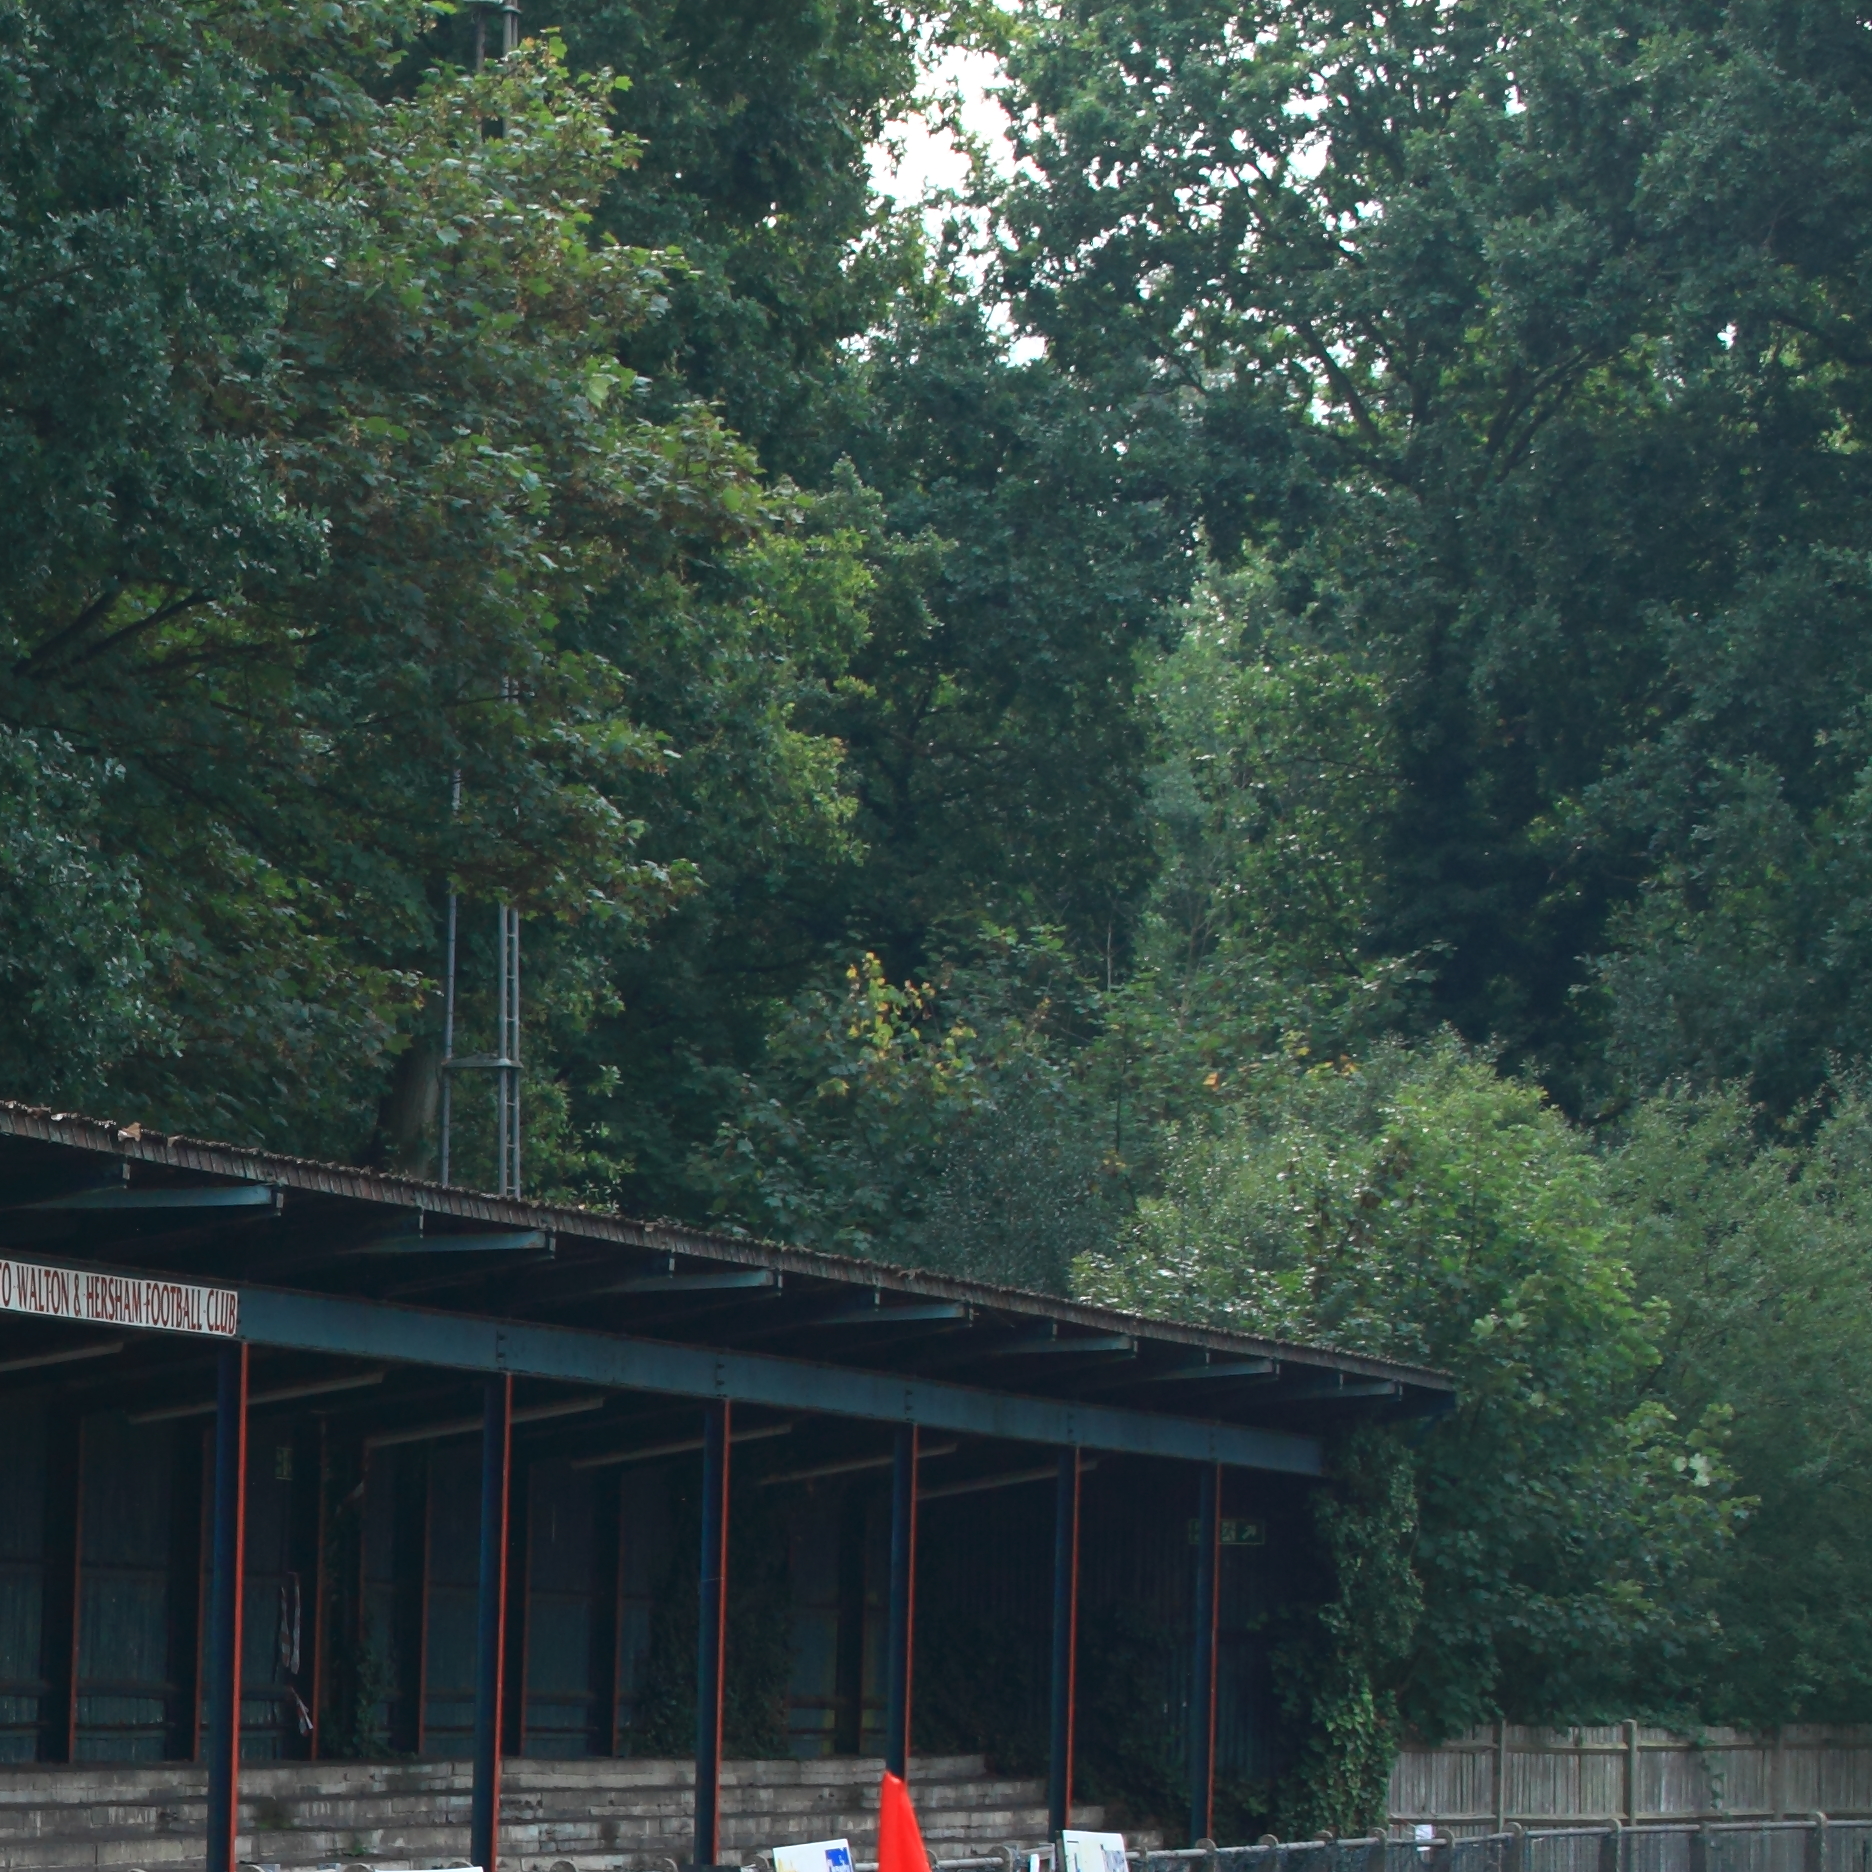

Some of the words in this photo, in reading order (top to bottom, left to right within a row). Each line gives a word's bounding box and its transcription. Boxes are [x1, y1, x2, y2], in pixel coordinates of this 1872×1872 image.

[17, 1264, 70, 1315] WALTON
[73, 1275, 82, 1317] &
[86, 1275, 142, 1323] HERSHAM
[146, 1283, 203, 1331] FOOTBALL
[206, 1288, 237, 1336] CLUB
